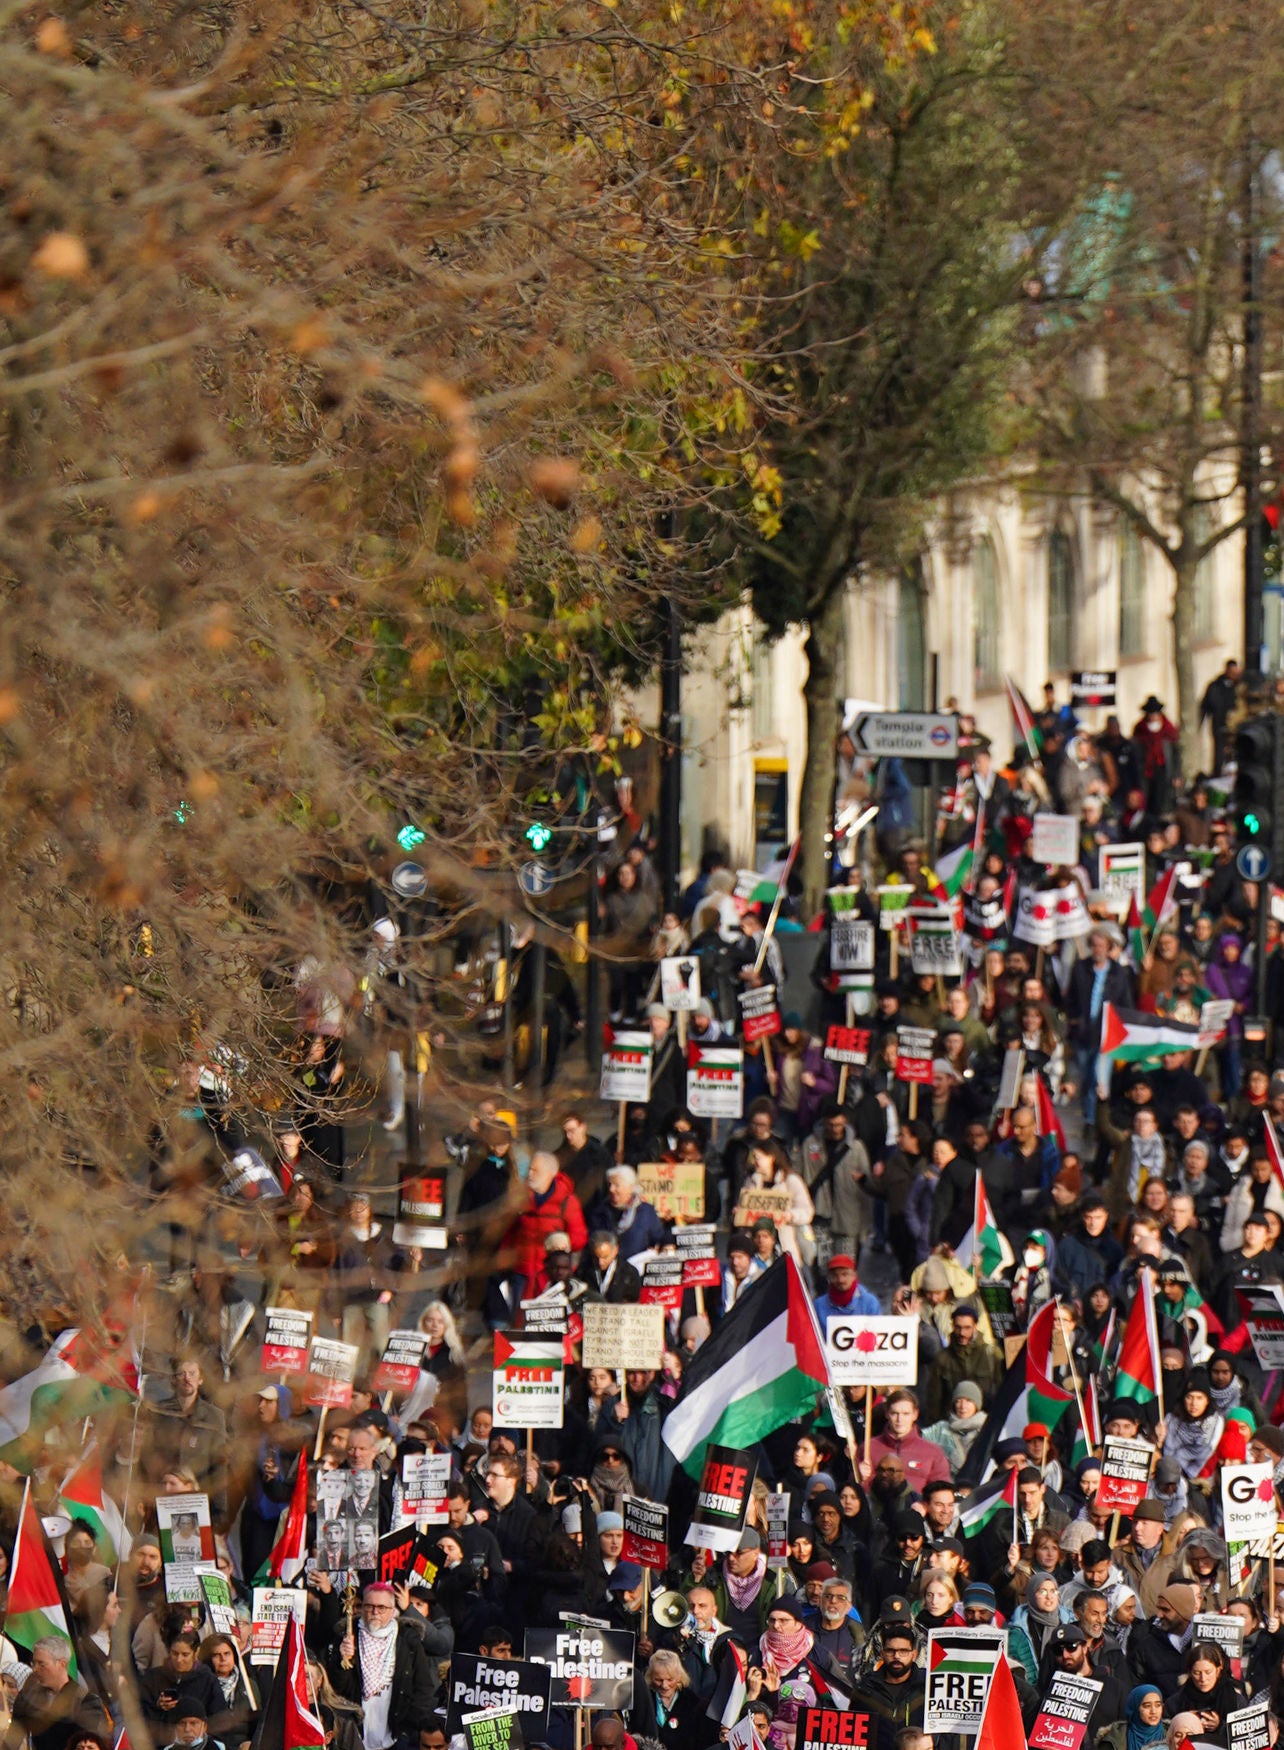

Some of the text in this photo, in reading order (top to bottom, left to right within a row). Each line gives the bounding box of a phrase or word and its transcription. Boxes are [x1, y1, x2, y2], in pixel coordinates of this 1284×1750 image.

[827, 1024, 871, 1052] FREE
[506, 1367, 555, 1382] FREE
[832, 1358, 908, 1369] Stop the massacre
[498, 1384, 560, 1395] PALESTINE
[1108, 1448, 1149, 1464] FREEDOM
[1103, 1462, 1149, 1482] PALESTINE
[556, 1634, 604, 1657] Free
[475, 1661, 520, 1687] Free
[1051, 1682, 1094, 1705] FREEDOM
[1041, 1700, 1090, 1723] PALESTINE
[805, 1709, 870, 1746] FREE
[1231, 1715, 1266, 1736] FREEDOM
